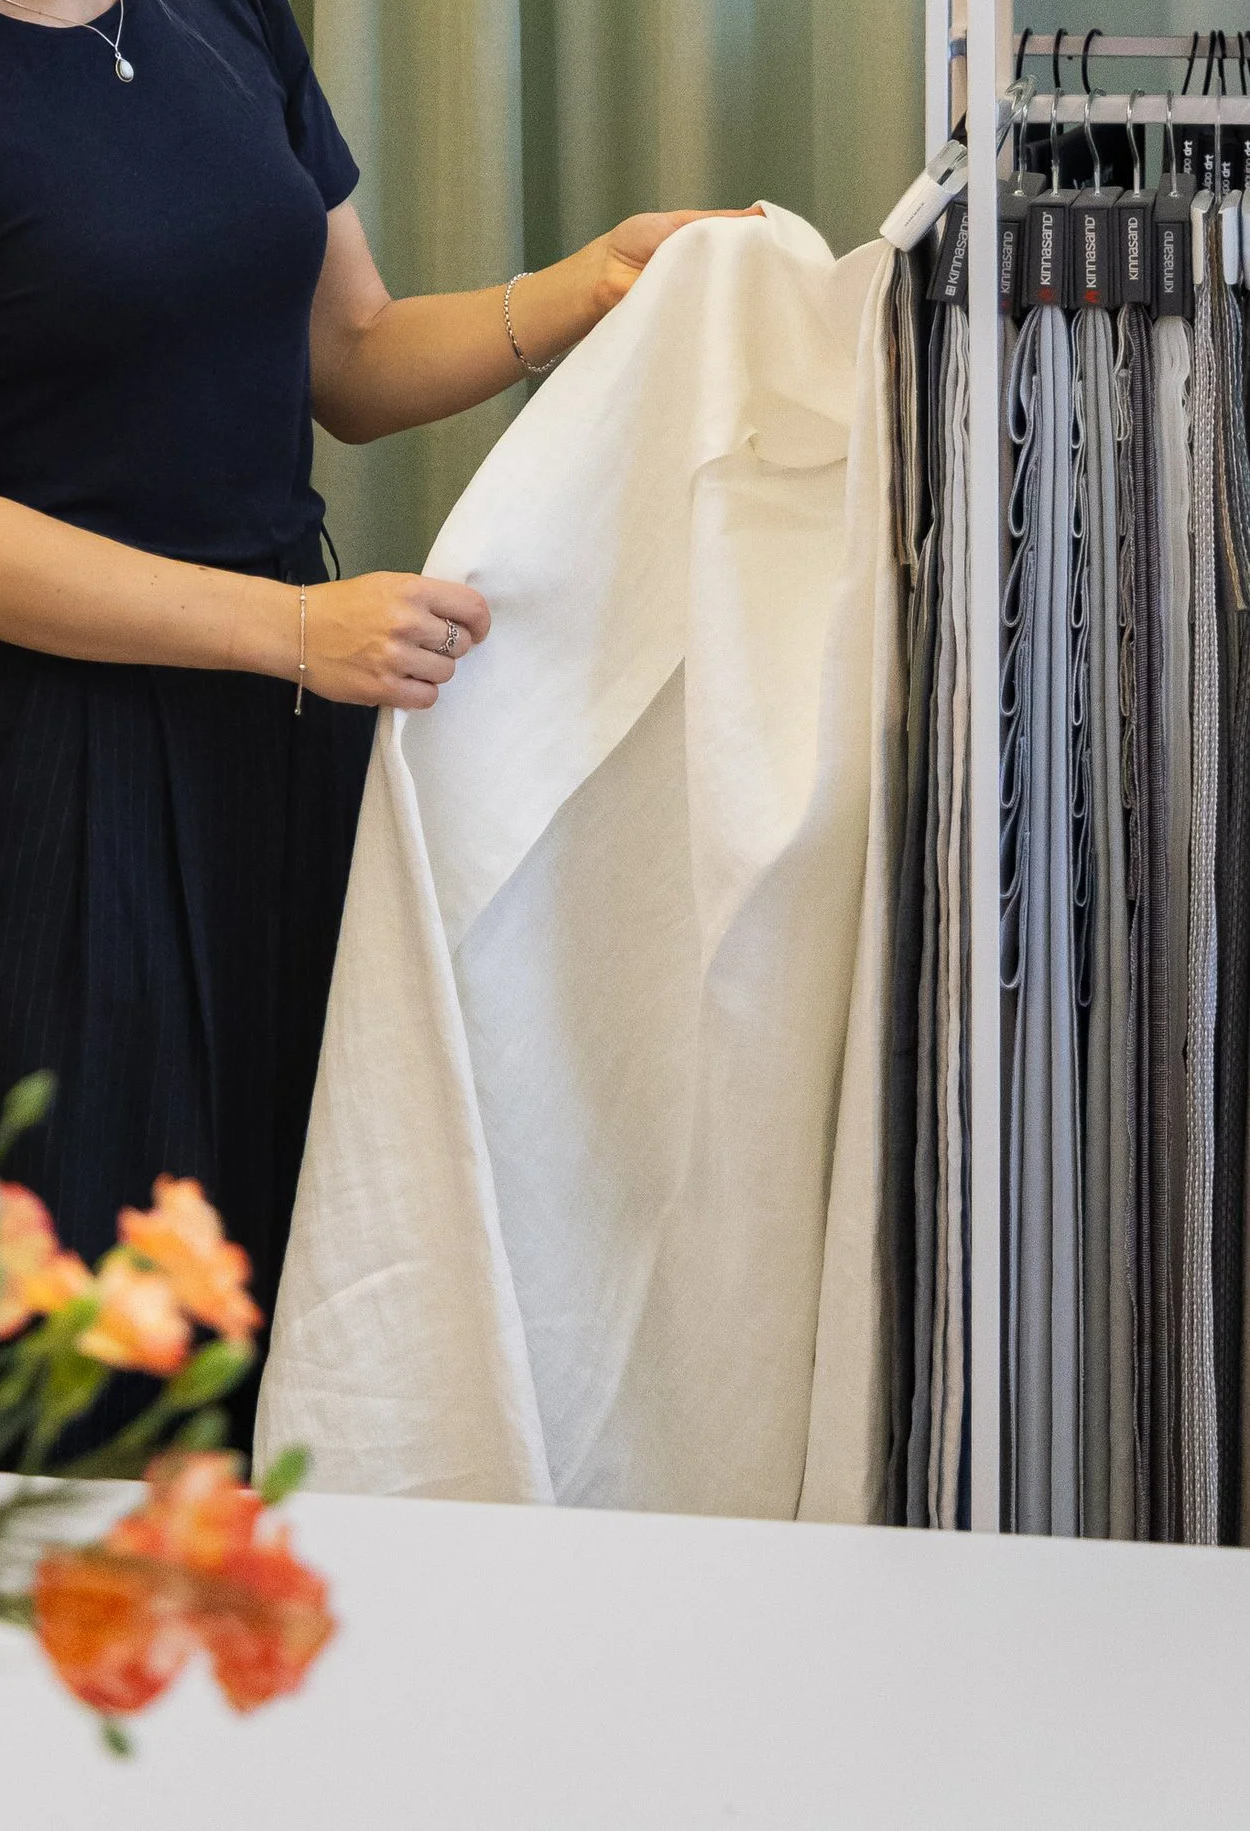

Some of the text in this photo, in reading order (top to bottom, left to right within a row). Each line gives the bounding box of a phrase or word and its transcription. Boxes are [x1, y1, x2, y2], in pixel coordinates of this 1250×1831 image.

[1183, 140, 1193, 157] drt
[1204, 154, 1214, 170] drt
[1222, 162, 1231, 178] drt
